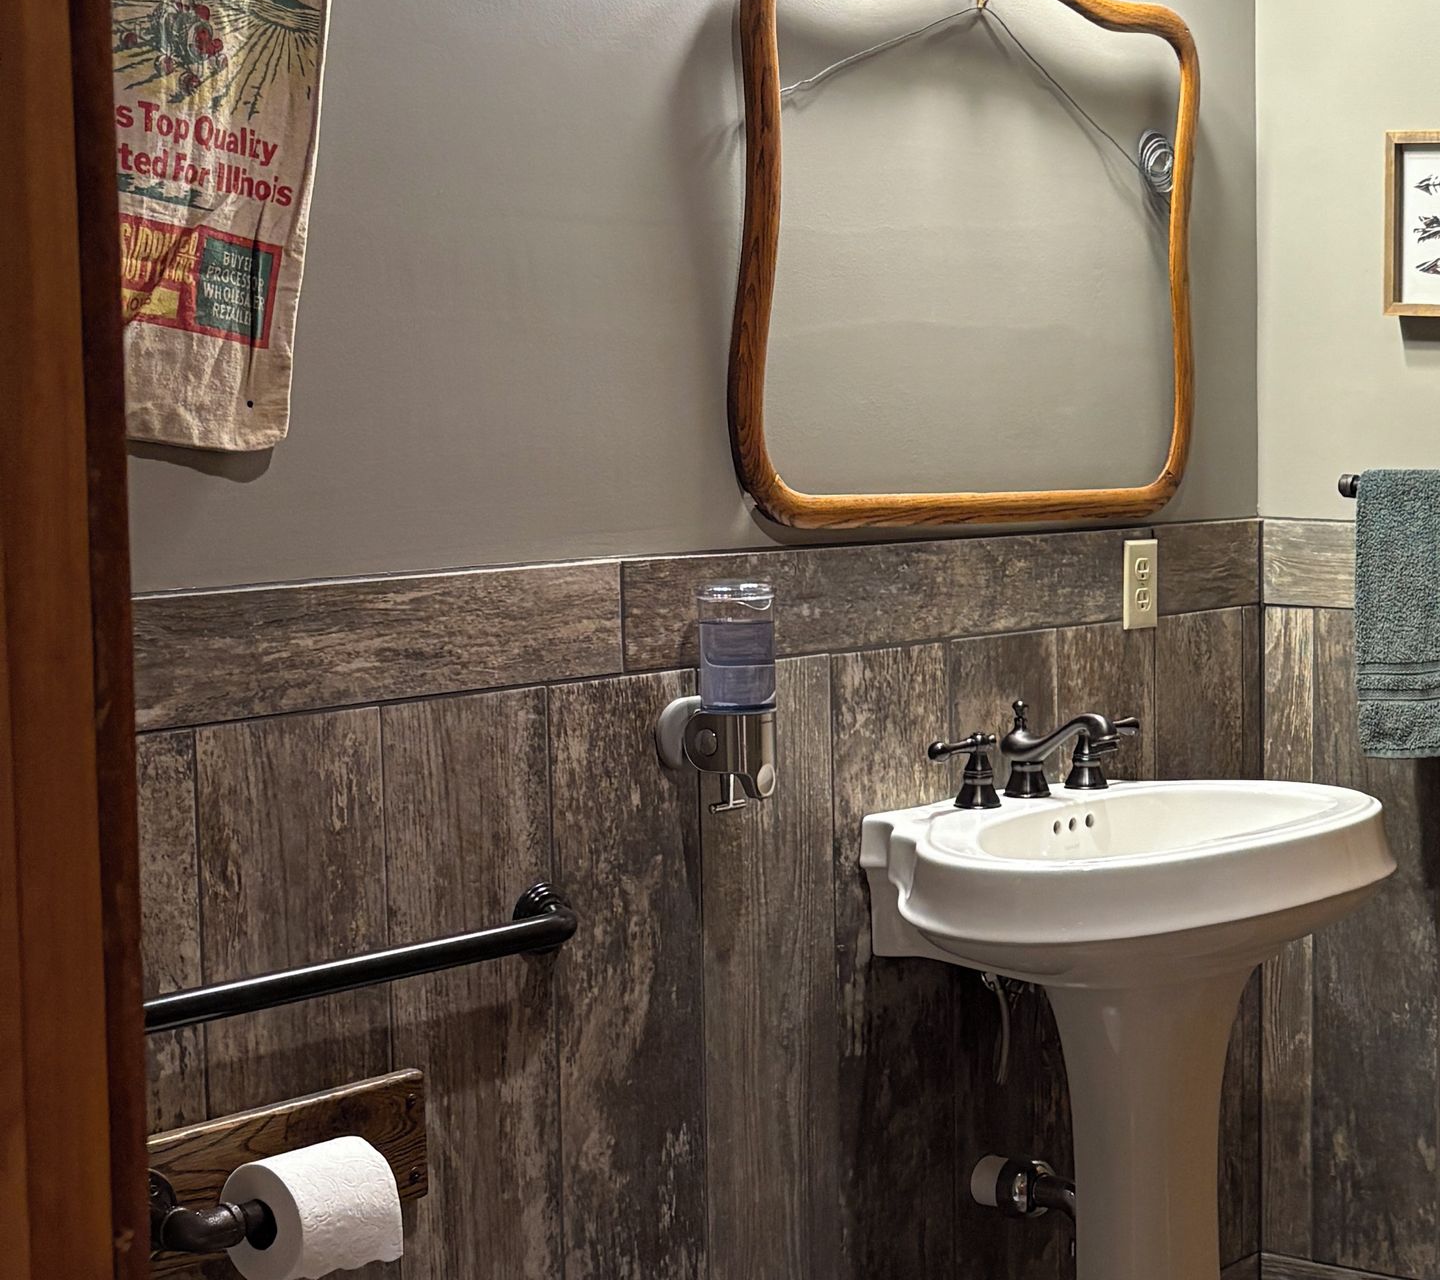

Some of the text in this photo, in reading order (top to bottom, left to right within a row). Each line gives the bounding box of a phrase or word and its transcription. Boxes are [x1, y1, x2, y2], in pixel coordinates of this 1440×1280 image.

[137, 100, 190, 144] Top
[194, 115, 279, 167] Quality
[171, 151, 211, 188] For
[215, 161, 293, 207] Illinois
[203, 282, 265, 311] WHOLESAER
